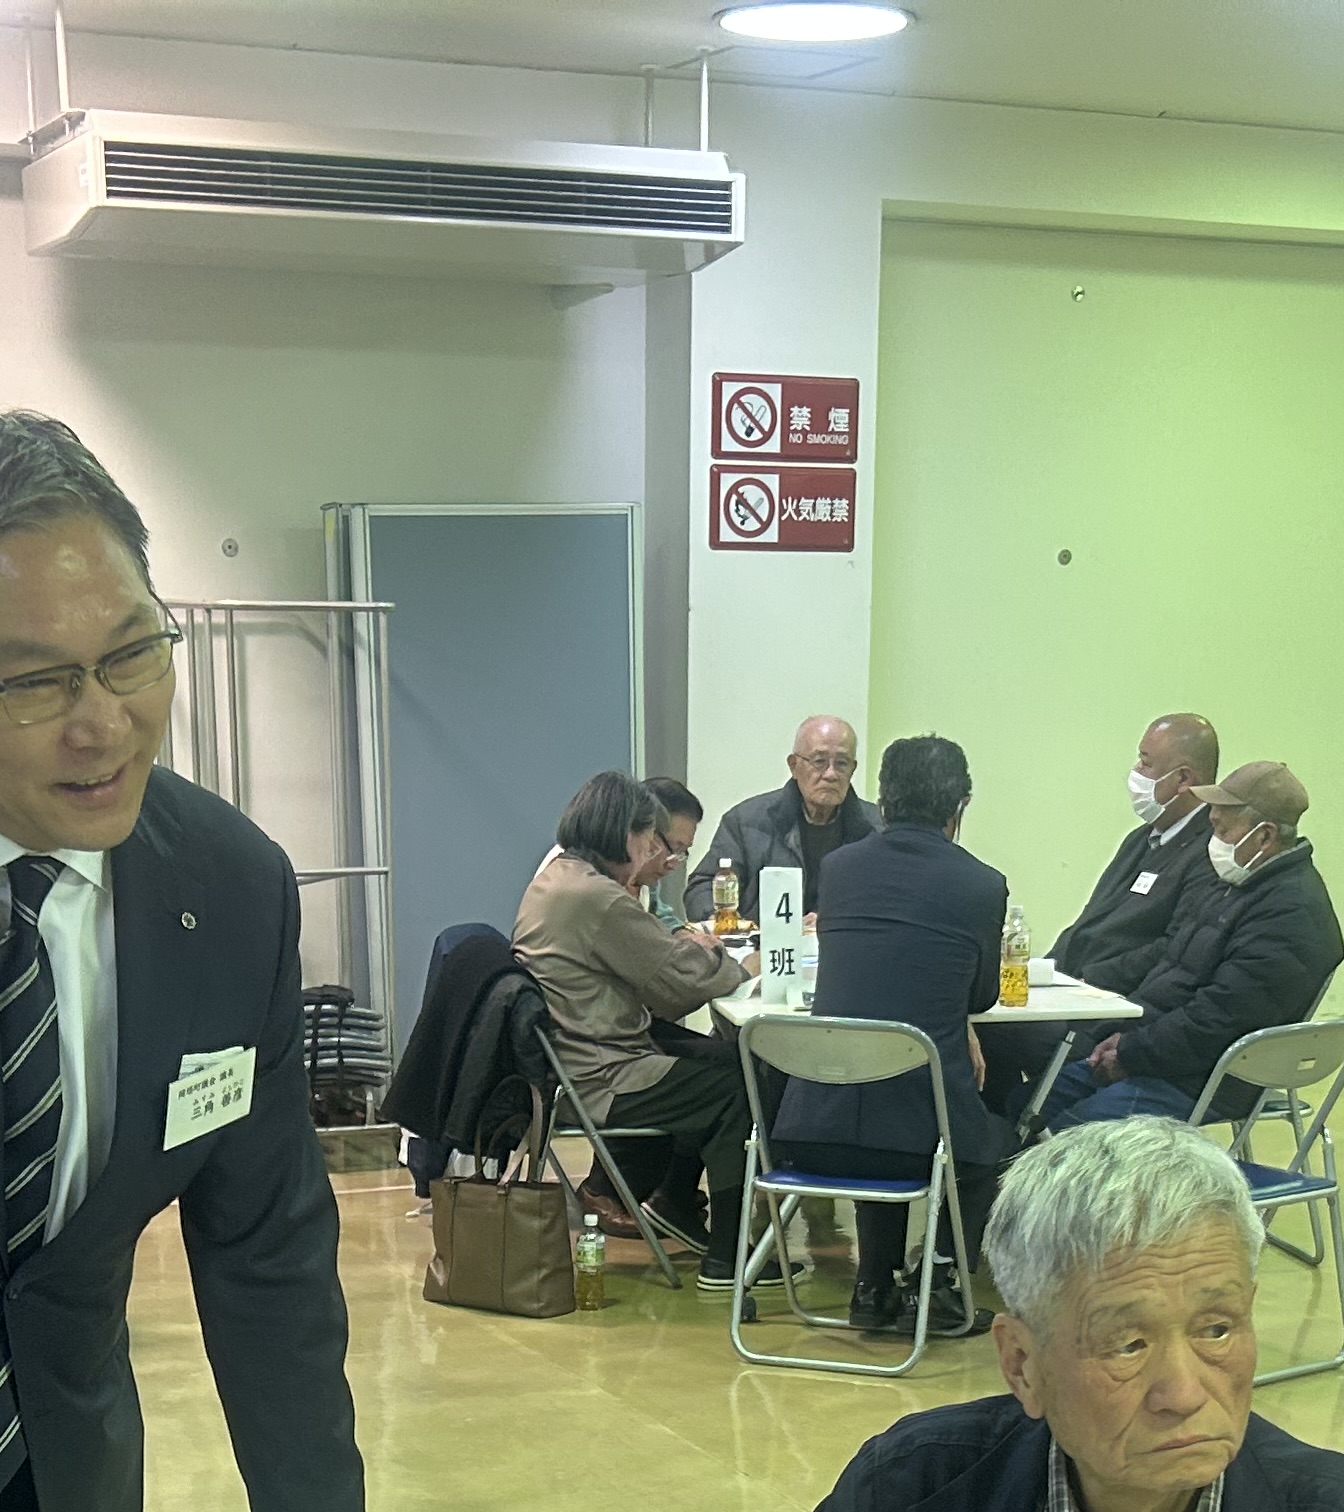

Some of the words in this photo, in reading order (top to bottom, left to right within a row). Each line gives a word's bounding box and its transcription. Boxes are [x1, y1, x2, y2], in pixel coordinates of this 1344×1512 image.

[789, 405, 850, 432] 禁煙
[789, 433, 803, 444] NO
[807, 433, 849, 445] SMOKING
[781, 496, 849, 523] 火気厳禁
